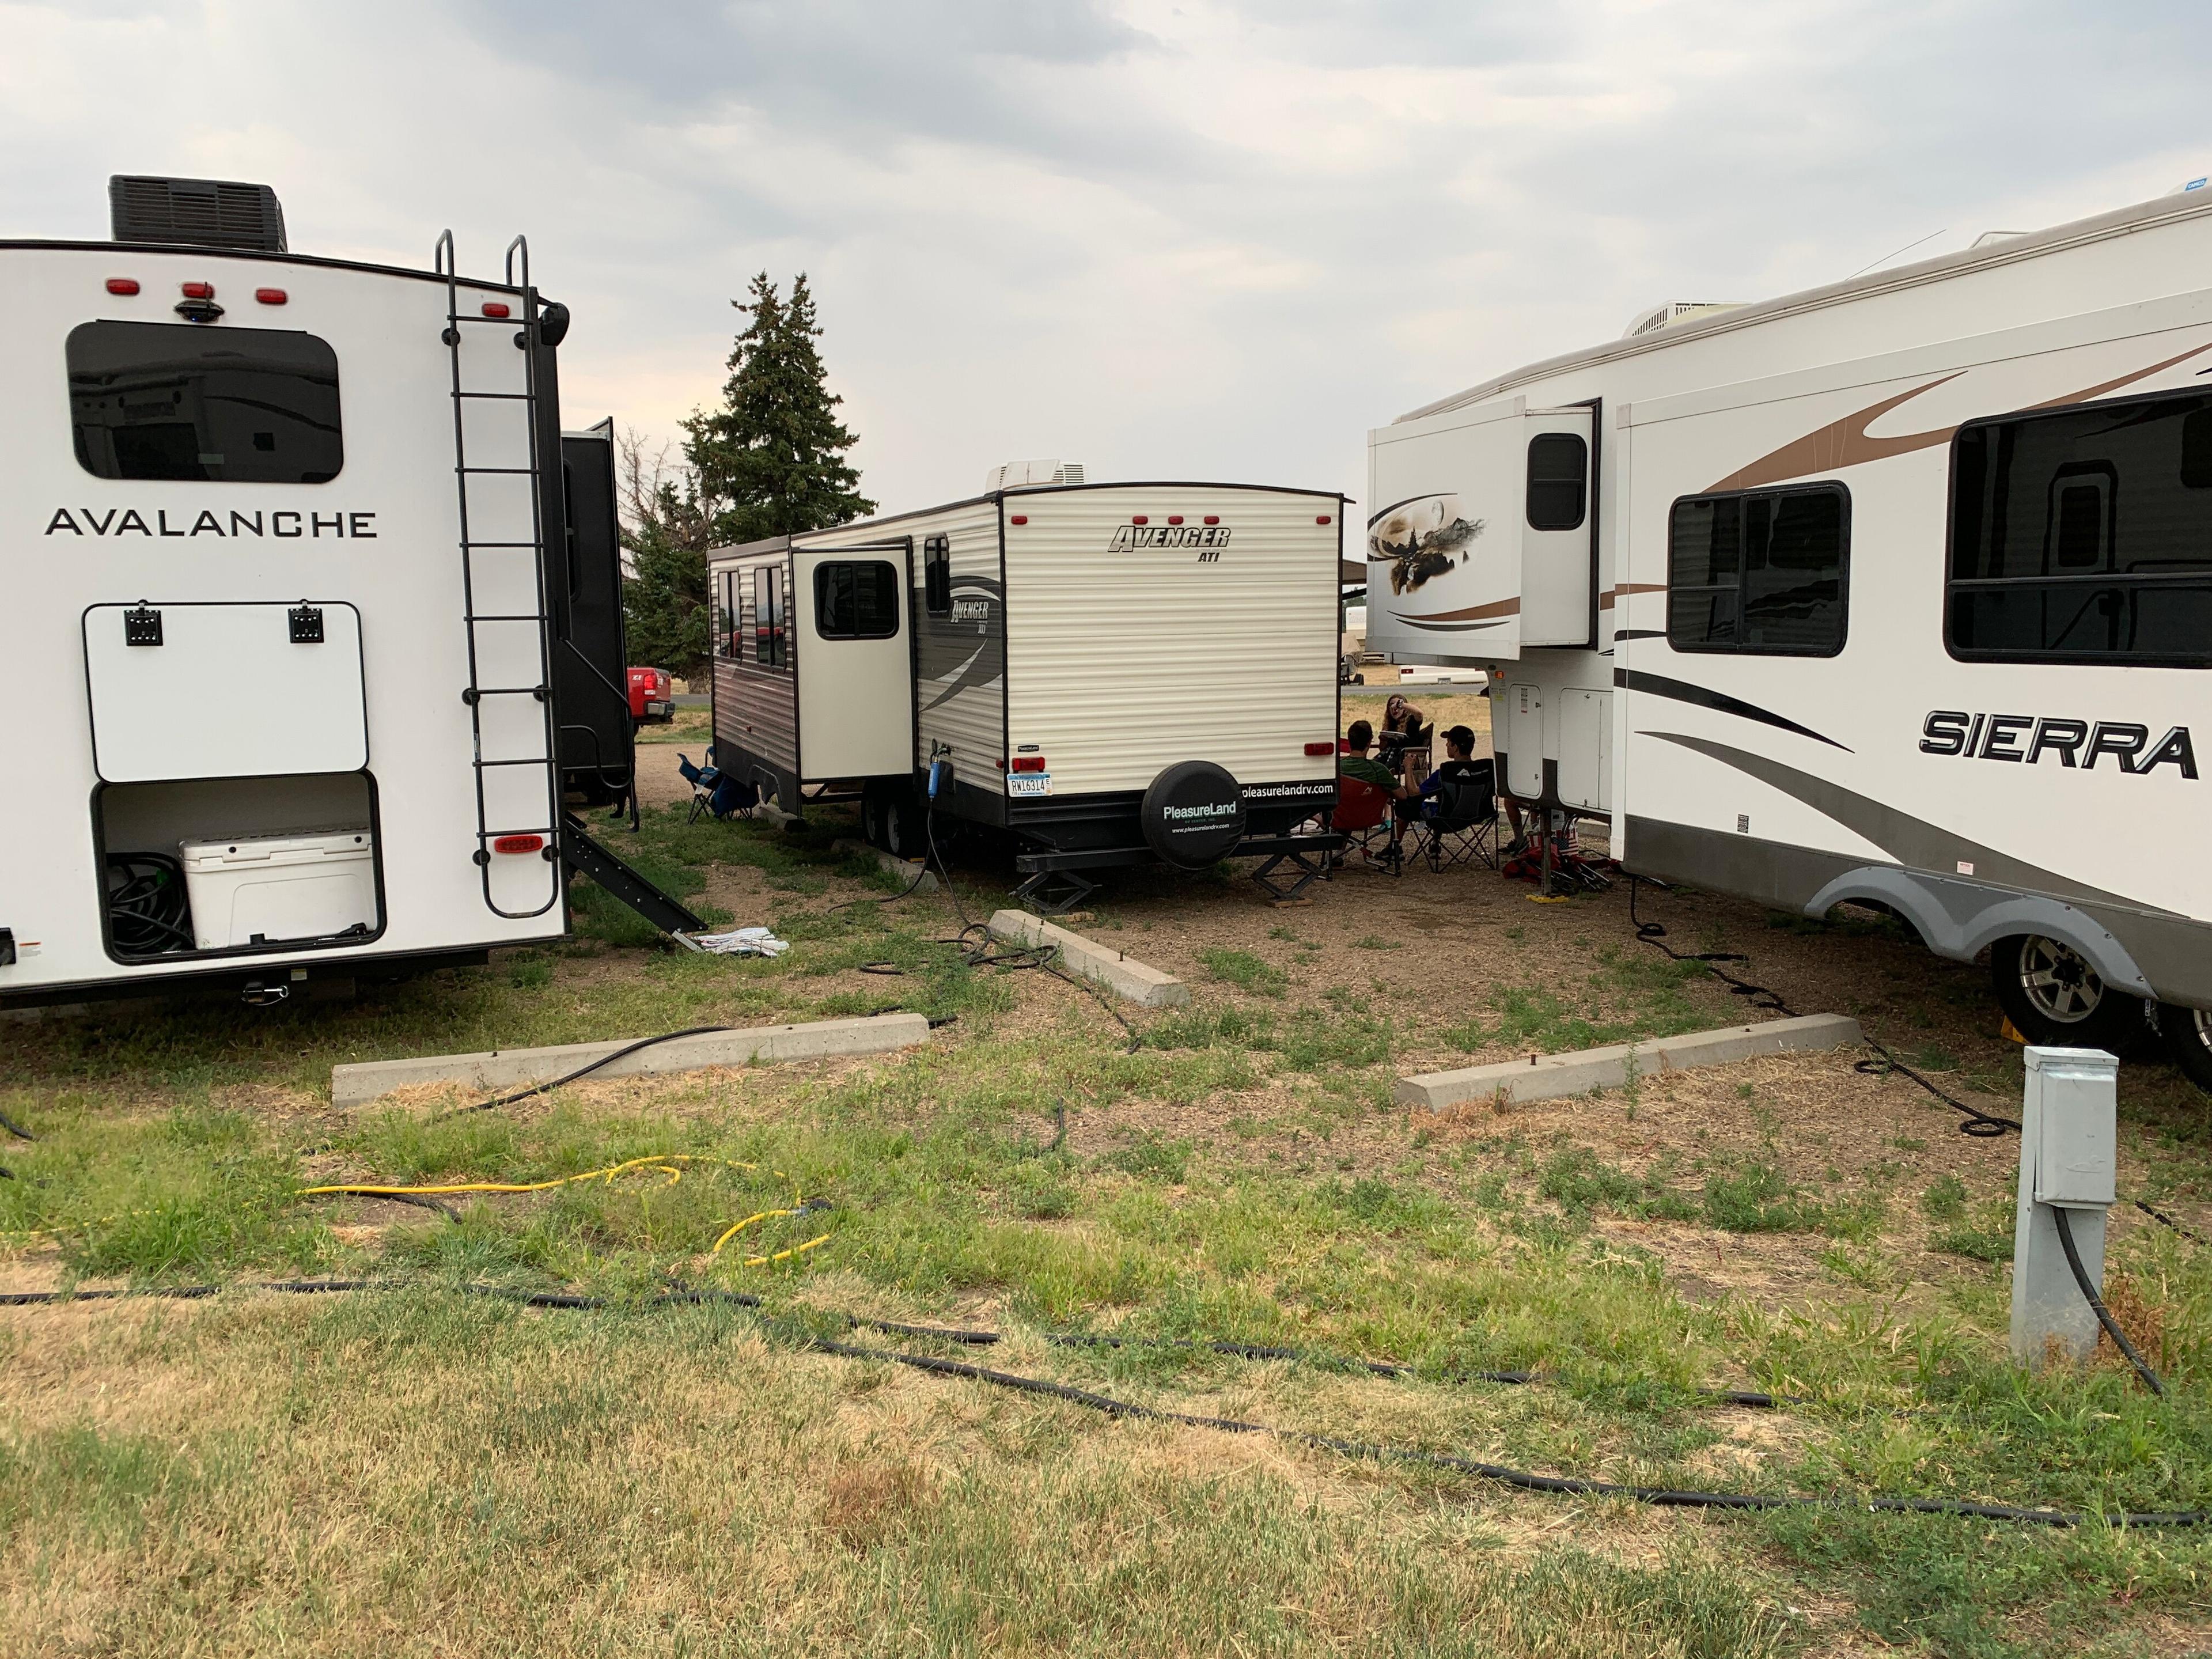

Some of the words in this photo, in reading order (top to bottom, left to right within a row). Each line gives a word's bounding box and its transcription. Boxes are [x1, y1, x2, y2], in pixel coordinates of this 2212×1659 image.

[44, 508, 378, 539] AVALANCHE
[1107, 525, 1232, 552] AVENGER
[1198, 552, 1220, 562] ATI
[950, 600, 989, 623] AVENGER
[1919, 710, 2199, 781] SIERRA
[1012, 779, 1044, 791] RW16314
[1163, 801, 1237, 820] PleasureLand
[1172, 824, 1229, 834] www.pleasurelandrv.com
